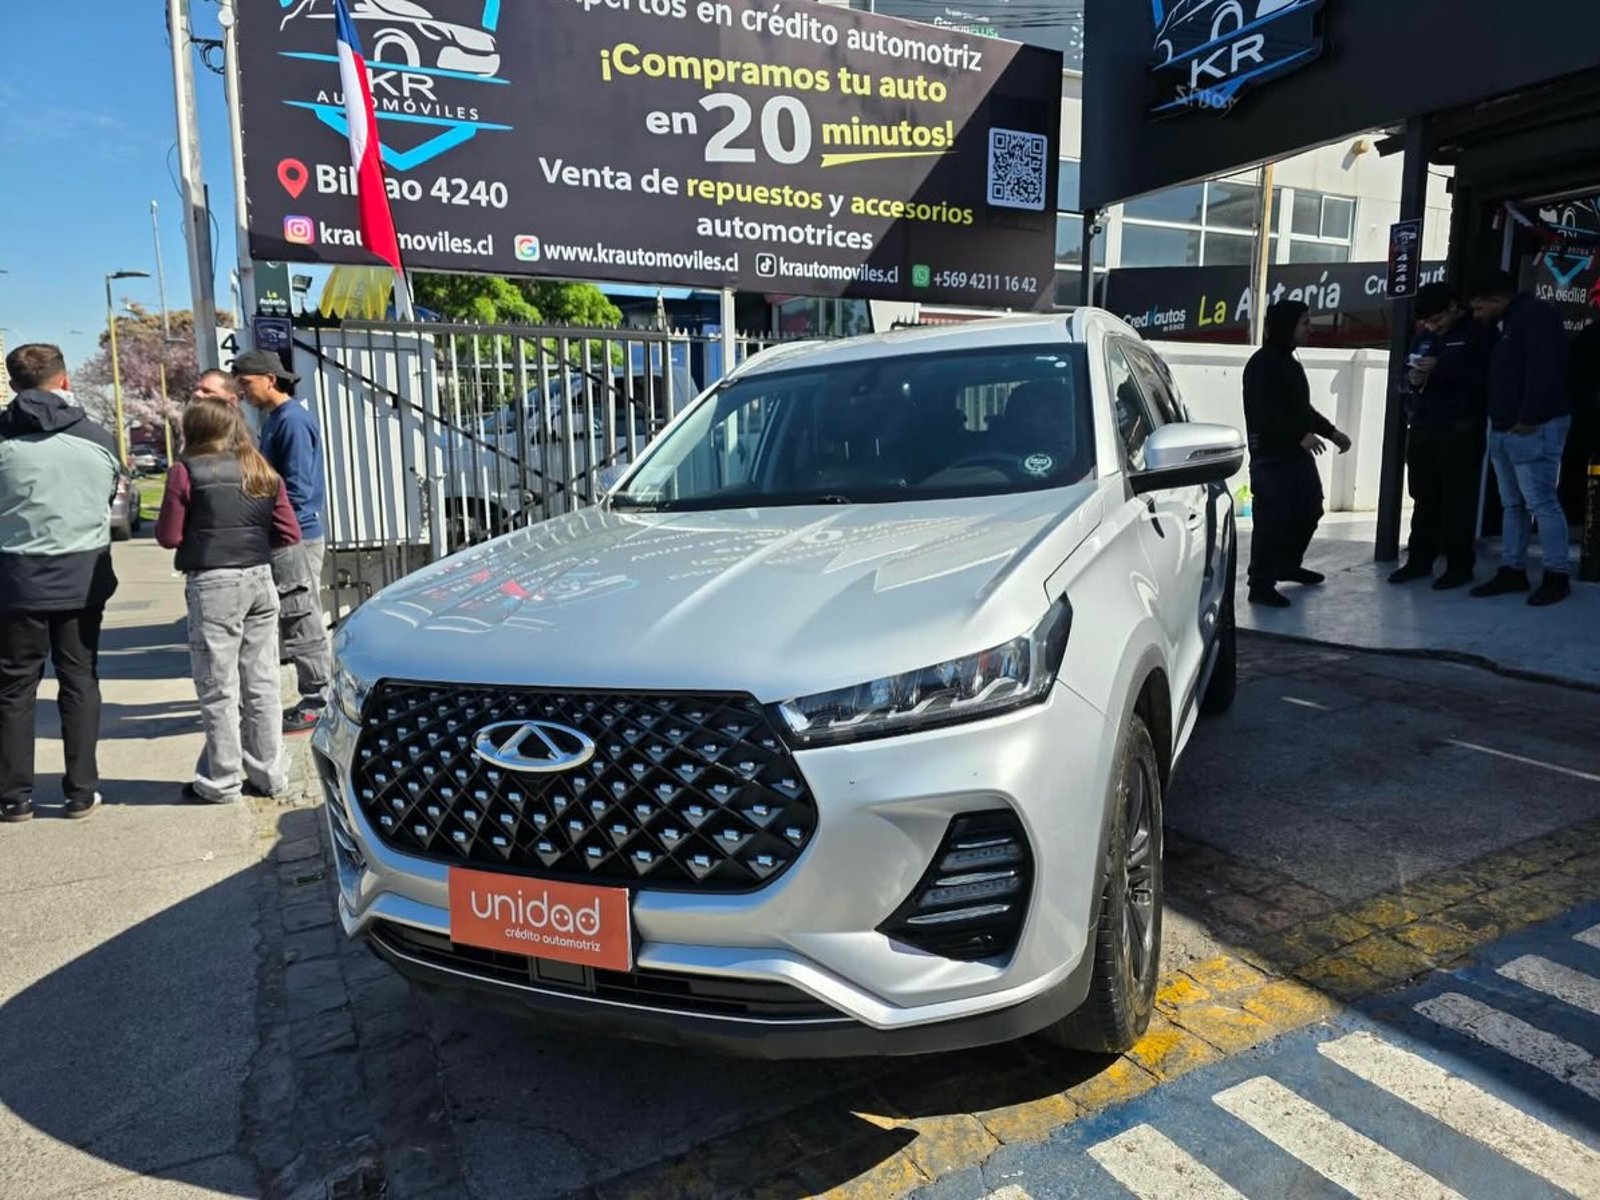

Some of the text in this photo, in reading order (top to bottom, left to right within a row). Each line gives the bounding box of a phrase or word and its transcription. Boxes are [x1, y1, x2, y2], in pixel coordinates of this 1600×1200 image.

[697, 2, 733, 26] en
[742, 4, 838, 45] crédito
[847, 28, 982, 71] automotriz
[600, 42, 947, 103] ¡Compramos tu auto
[1189, 34, 1265, 89] KR
[364, 68, 437, 101] KR
[316, 90, 479, 121] AUOMÓVILES
[645, 92, 955, 165] en 20 minutos!
[316, 164, 509, 208] Bilao 4240
[539, 156, 974, 226] Venta de repuestos y accesorios
[319, 222, 494, 256] kraumoviles.cl
[696, 214, 874, 250] automotrices
[544, 241, 739, 273] www.krautomoviles.cl
[779, 258, 898, 284] krautomoviles.cl
[934, 272, 1038, 294] +569 4211 16 42
[1198, 270, 1342, 327] La Atería
[471, 889, 600, 936] unidad
[505, 927, 601, 953] crédito automotriz
